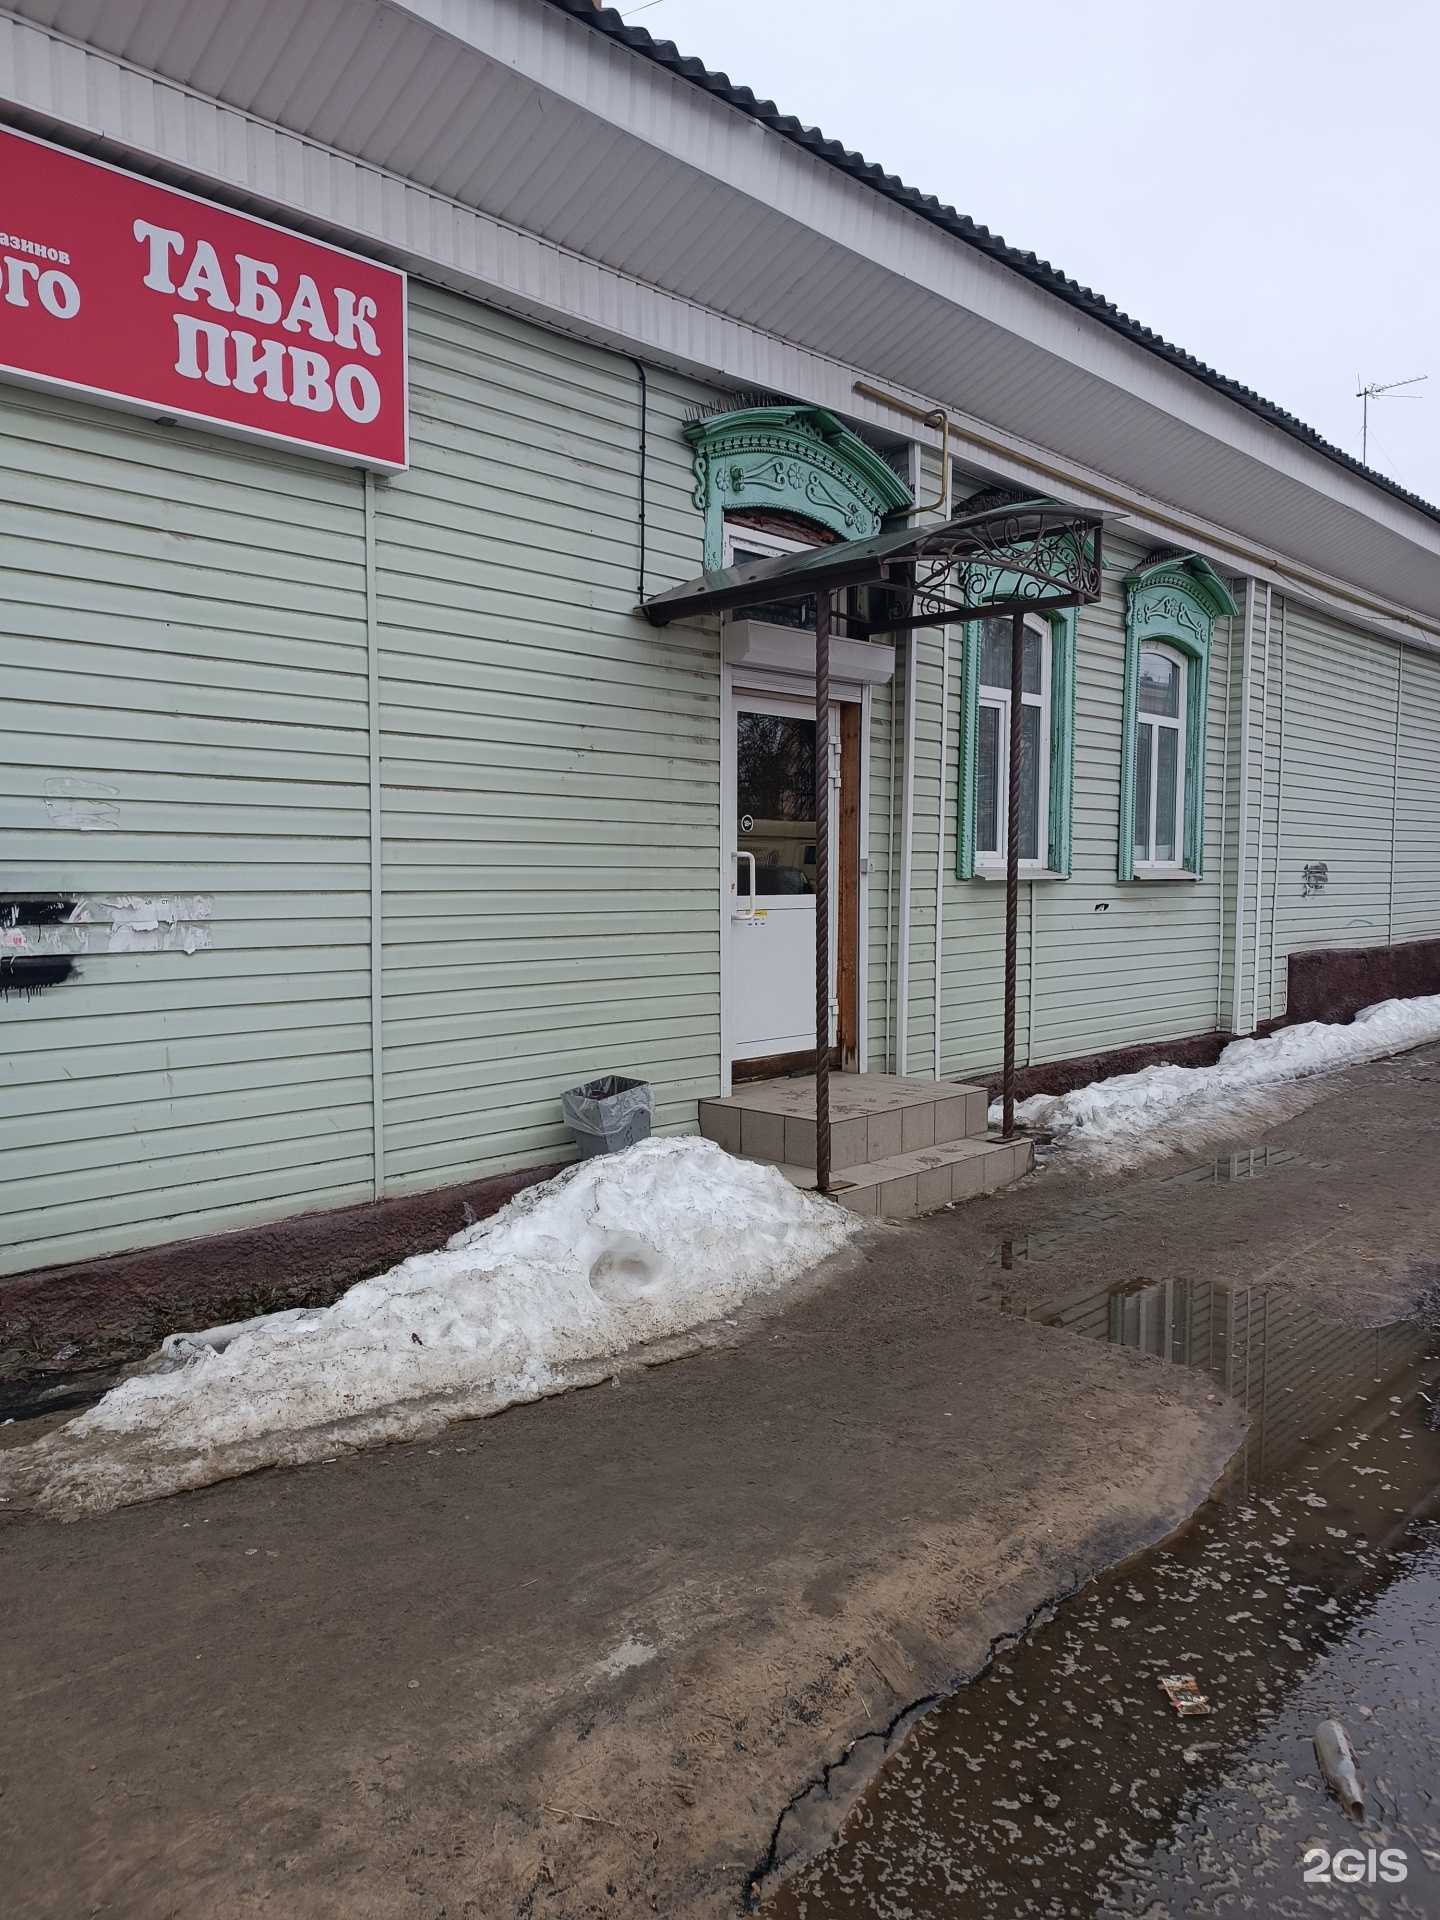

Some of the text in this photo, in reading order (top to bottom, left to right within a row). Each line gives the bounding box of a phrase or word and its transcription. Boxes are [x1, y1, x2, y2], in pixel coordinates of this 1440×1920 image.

[0, 256, 80, 319] ГО
[133, 219, 381, 356] ТАБАК
[174, 314, 381, 424] ПИВО
